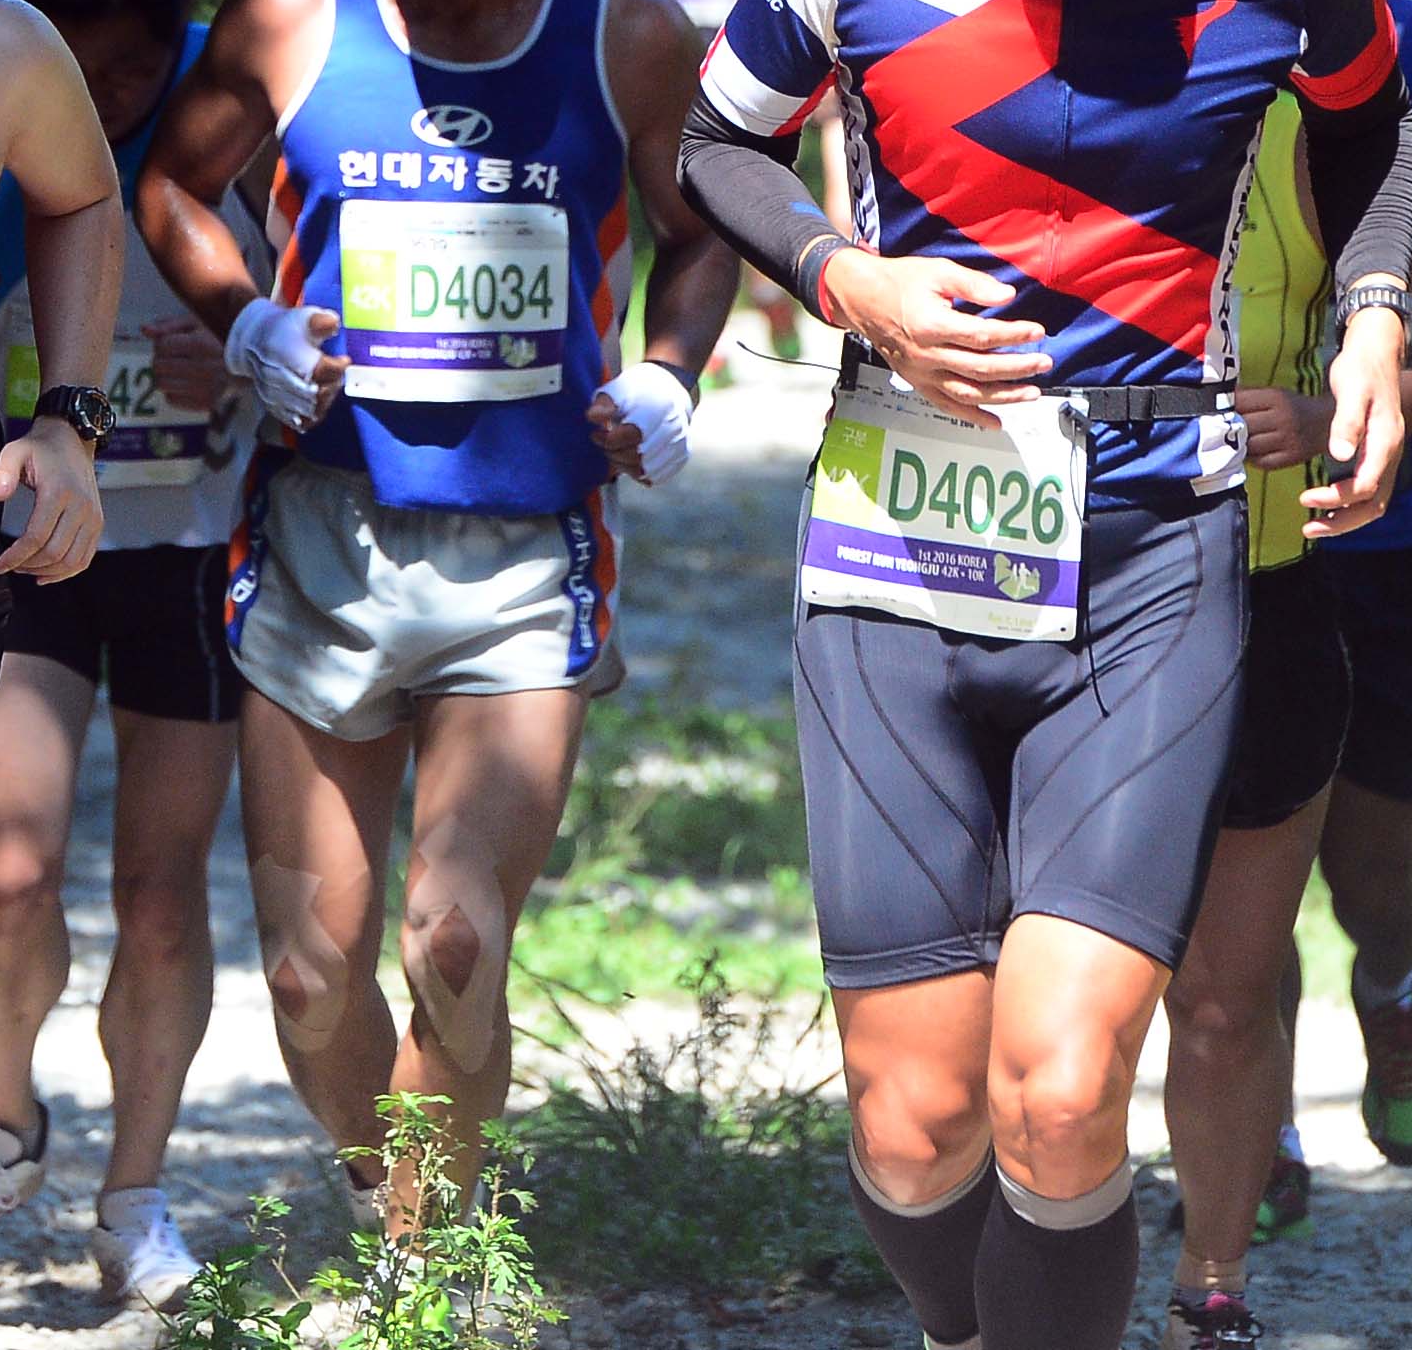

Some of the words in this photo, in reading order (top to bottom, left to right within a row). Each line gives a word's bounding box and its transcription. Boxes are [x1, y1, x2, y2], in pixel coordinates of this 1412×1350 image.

[338, 150, 561, 199] 현대자동차
[410, 263, 554, 321] D4034
[888, 449, 1065, 544] D4026
[895, 557, 940, 576] YEONGJU
[941, 564, 960, 579] 42K
[967, 567, 985, 582] 10K
[918, 549, 932, 562] 1st
[933, 551, 956, 566] 2016
[957, 554, 988, 569] KOREA
